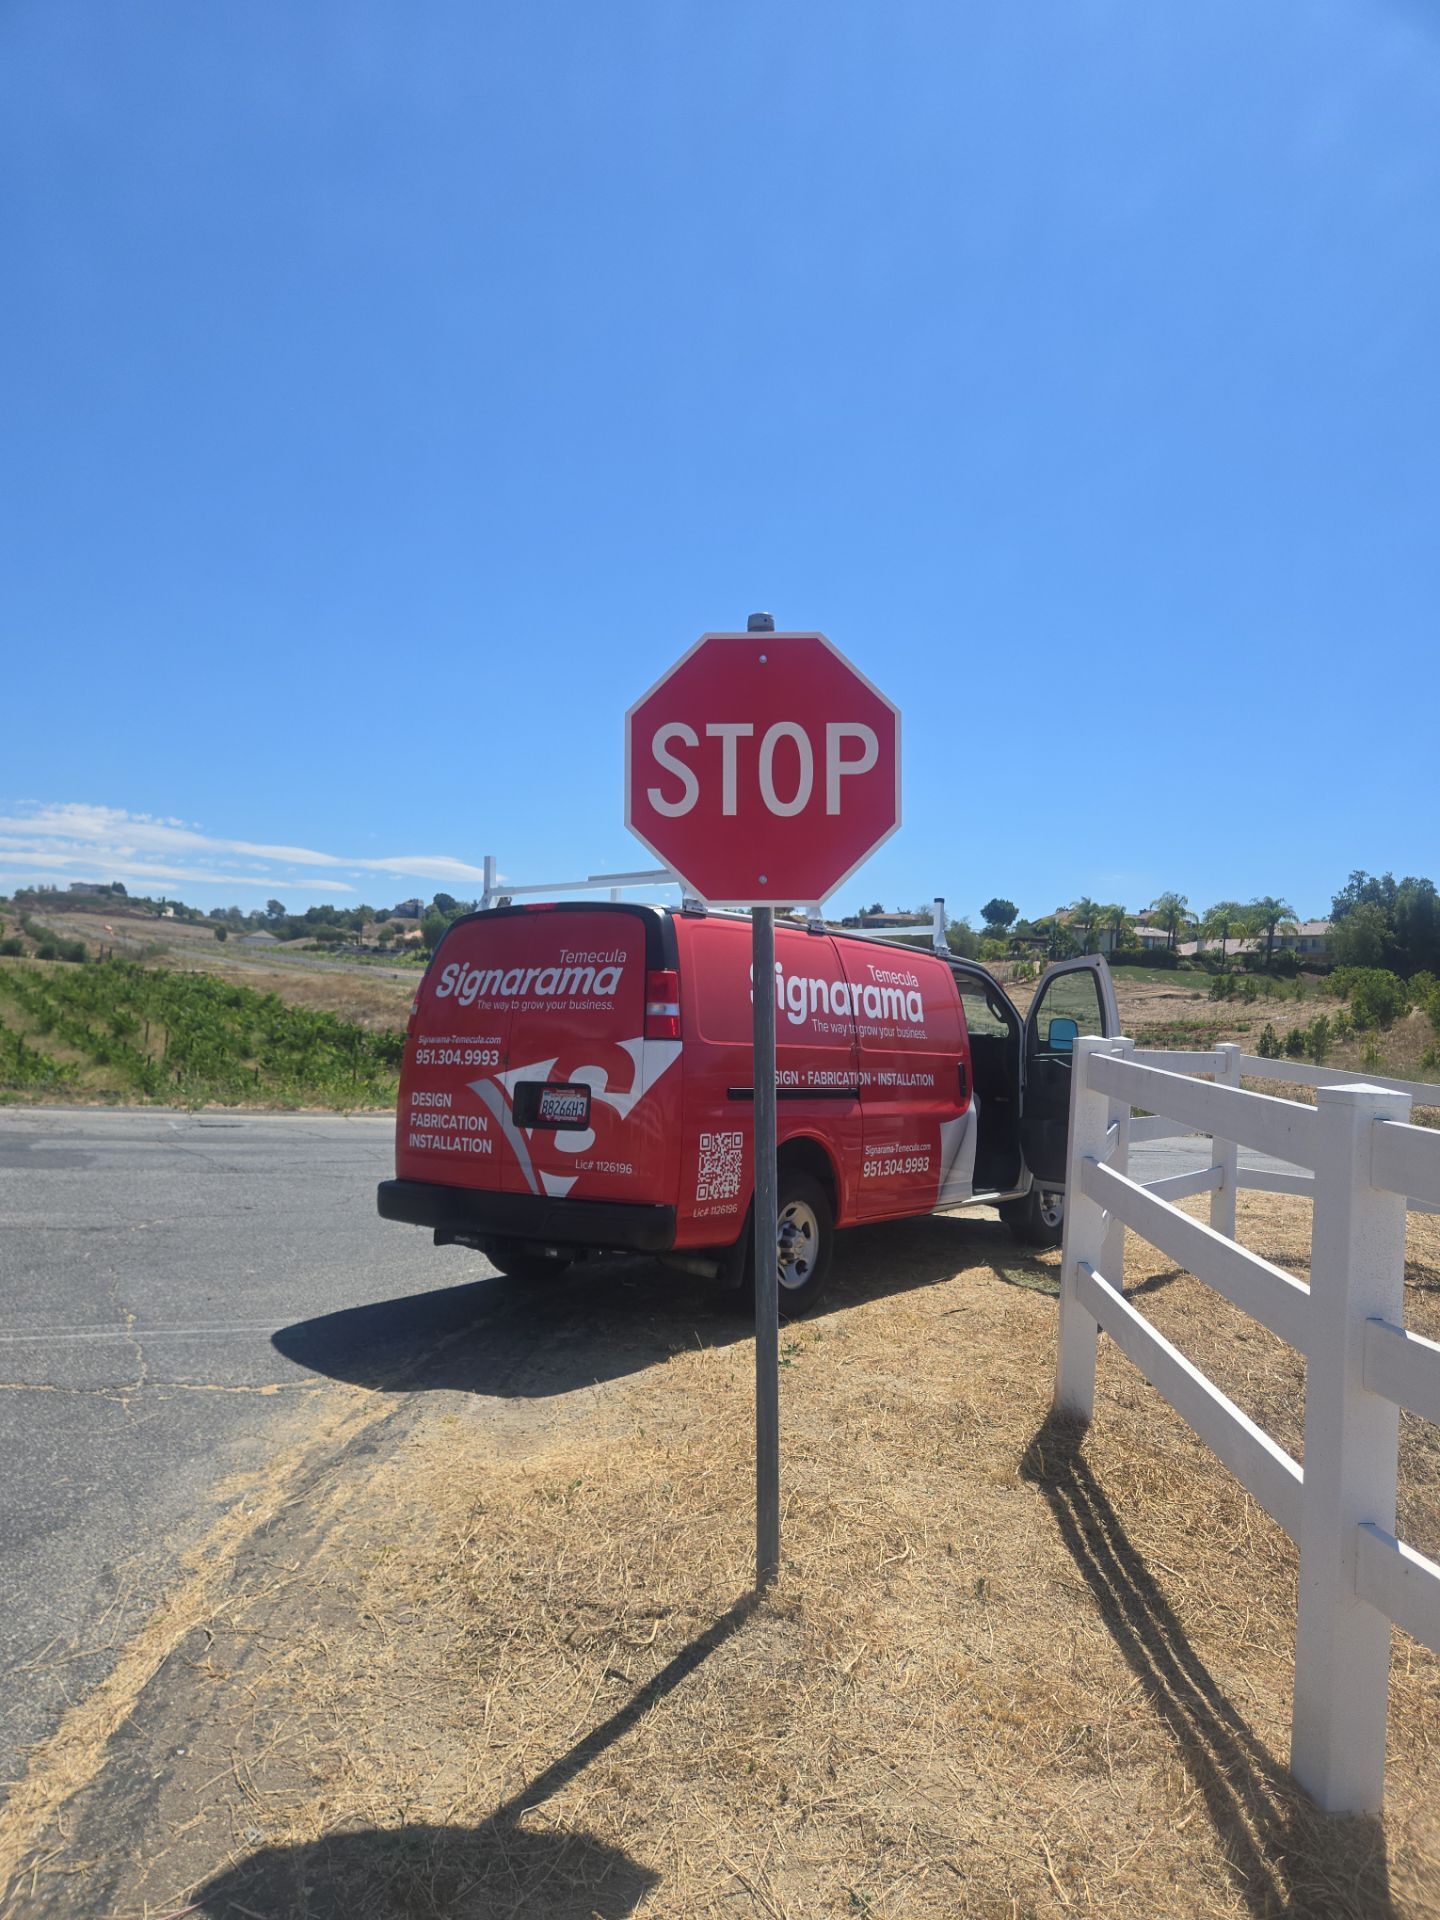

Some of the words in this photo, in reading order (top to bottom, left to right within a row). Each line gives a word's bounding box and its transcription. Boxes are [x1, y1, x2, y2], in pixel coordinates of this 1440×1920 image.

[647, 721, 879, 818] STOP
[559, 949, 627, 964] Temecula
[435, 962, 624, 1006] Signarama
[867, 964, 919, 988] Temecula
[477, 1000, 492, 1010] The
[493, 1001, 509, 1012] way
[511, 1000, 519, 1010] to
[521, 1001, 544, 1012] grow
[545, 1001, 567, 1012] your
[569, 1000, 615, 1010] business.
[812, 1018, 829, 1032] The
[831, 1023, 847, 1037] way
[849, 1023, 858, 1034] to
[859, 1025, 878, 1038] grow
[880, 1027, 896, 1039] your
[896, 1026, 928, 1040] business.
[416, 1048, 499, 1066] 951.304.9993
[774, 1071, 799, 1085] SIGN
[807, 1071, 871, 1086] FABRICATION
[877, 1072, 934, 1086] INSTALLATION
[411, 1092, 452, 1108] DESIGN
[410, 1112, 487, 1132] FABRICATION
[409, 1133, 492, 1154] INSTALLATION
[575, 1159, 594, 1170] Lic#
[596, 1161, 632, 1175] 1126196
[863, 1156, 930, 1178] 951.304.9993
[693, 1207, 709, 1218] Lic#
[711, 1203, 738, 1216] 1126196
